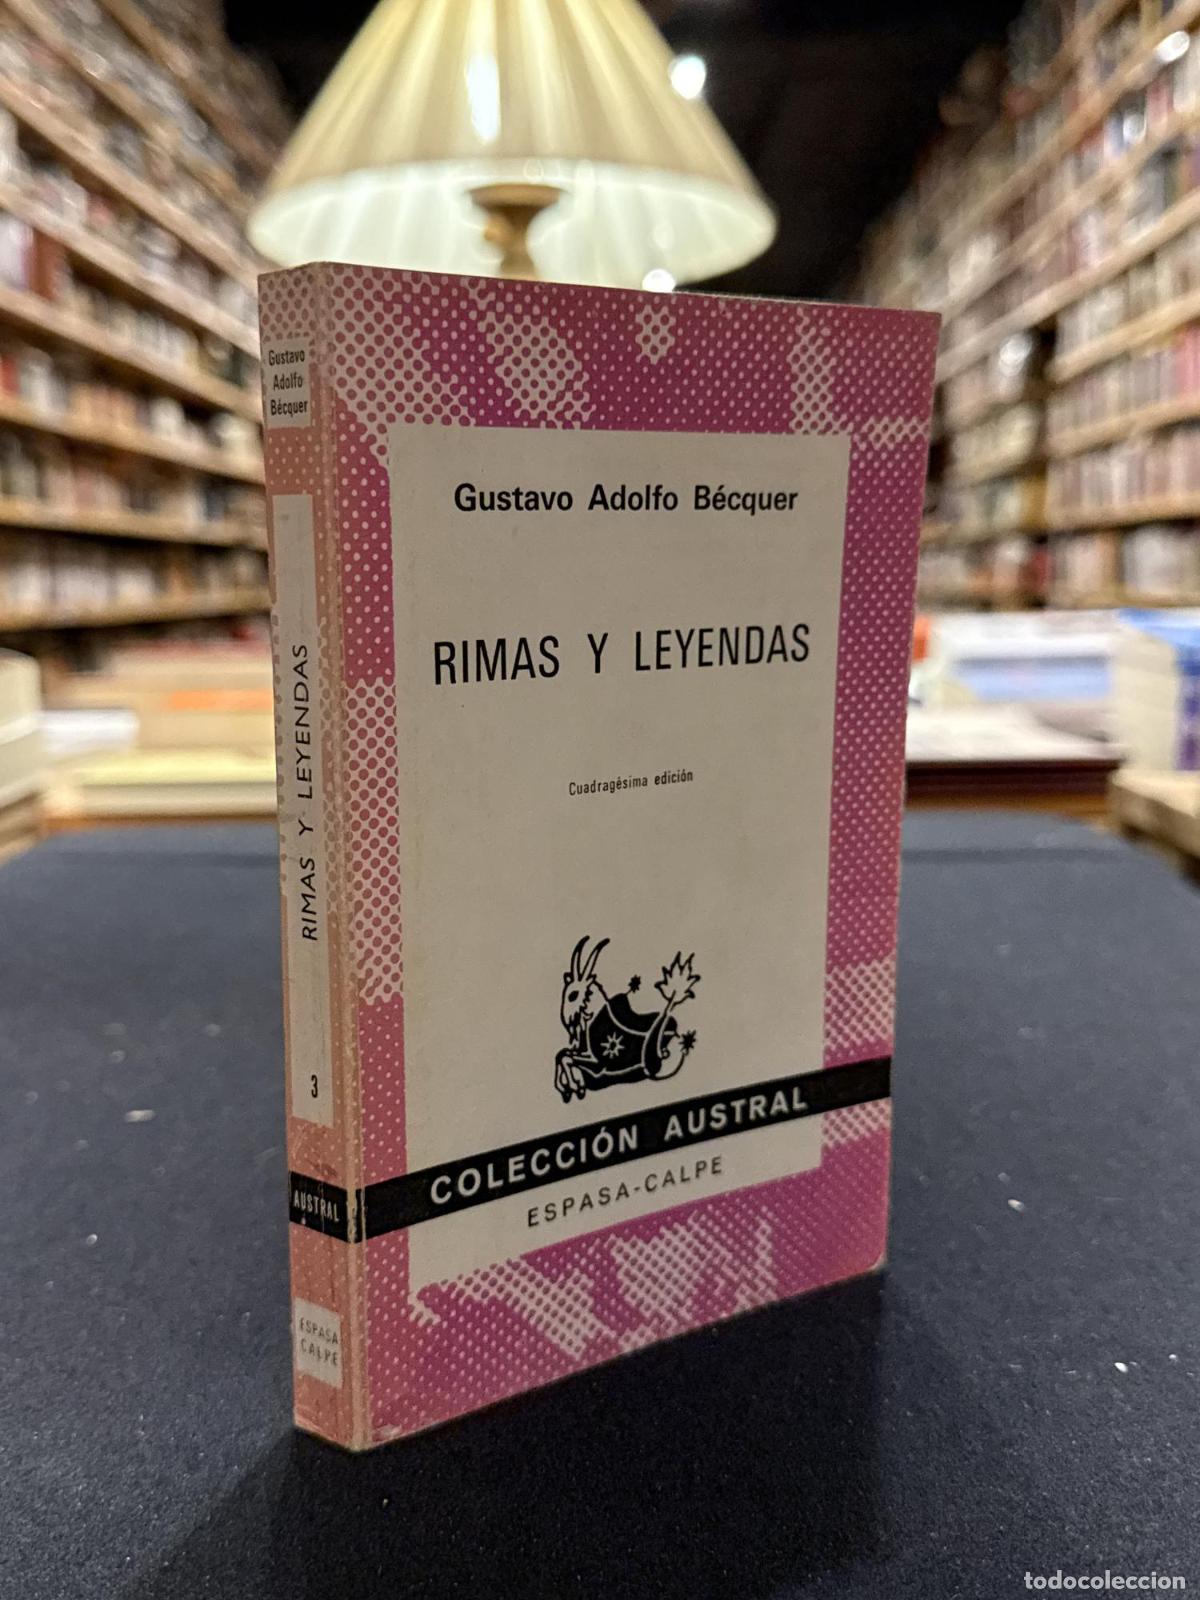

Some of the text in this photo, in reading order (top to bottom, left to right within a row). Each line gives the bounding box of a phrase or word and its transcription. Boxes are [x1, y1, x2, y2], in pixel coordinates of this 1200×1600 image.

[269, 350, 305, 366] Gustavo
[273, 371, 303, 391] Adolfo
[270, 399, 308, 417] Bécquer
[454, 483, 799, 516] Gustavo Adolfo Bécquer
[434, 623, 810, 685] RIMAS Y LEYENDAS
[292, 644, 318, 940] RIMAS Y LEYENDAS
[568, 769, 694, 796] Cuadragésima edición
[310, 1074, 319, 1099] 3
[430, 1086, 808, 1205] COLECCIÓN AUSTRAL
[528, 1156, 723, 1227] ESPASA-CALPE
[293, 1190, 340, 1223] AUSTRAL
[300, 1316, 339, 1345] ESPASA
[300, 1338, 339, 1367] CALPE
